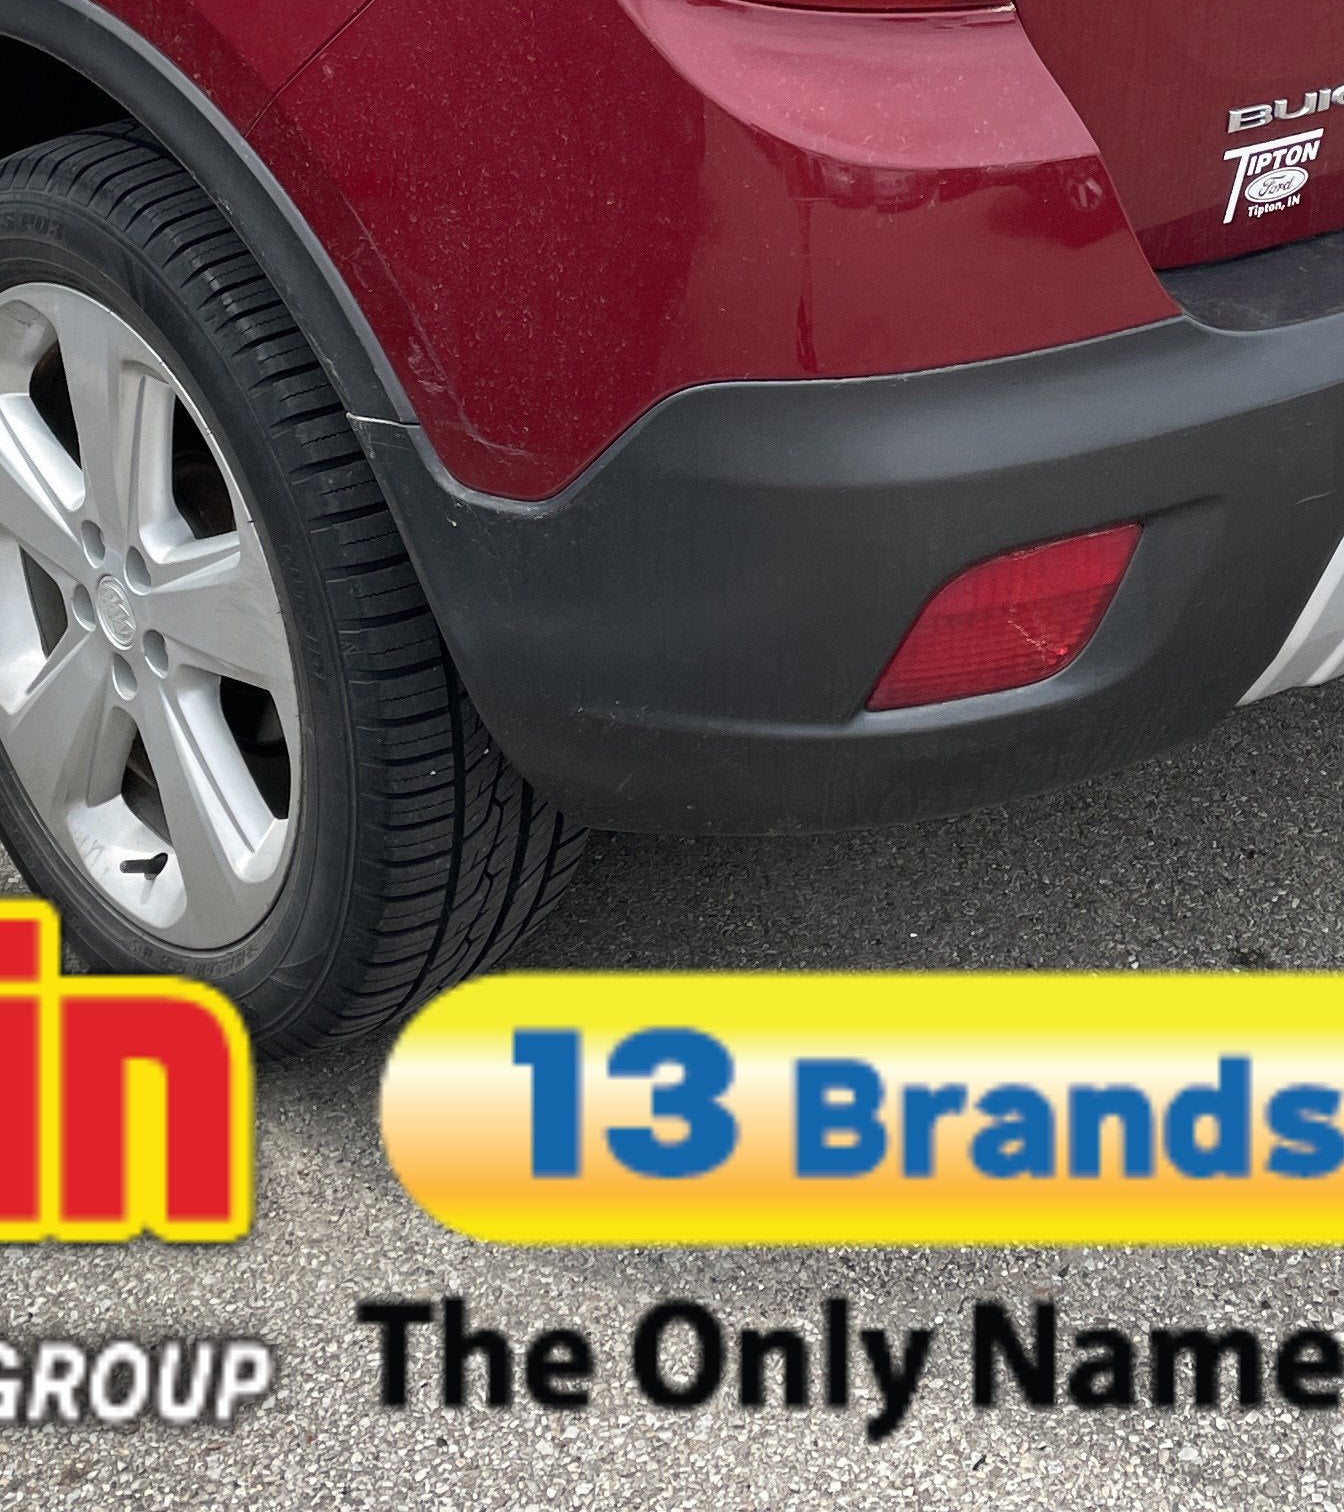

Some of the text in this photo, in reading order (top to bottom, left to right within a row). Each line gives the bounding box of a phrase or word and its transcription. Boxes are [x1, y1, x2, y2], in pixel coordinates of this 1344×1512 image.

[1222, 127, 1325, 225] TIPTON
[1256, 175, 1296, 197] Ford
[1287, 193, 1301, 207] IN
